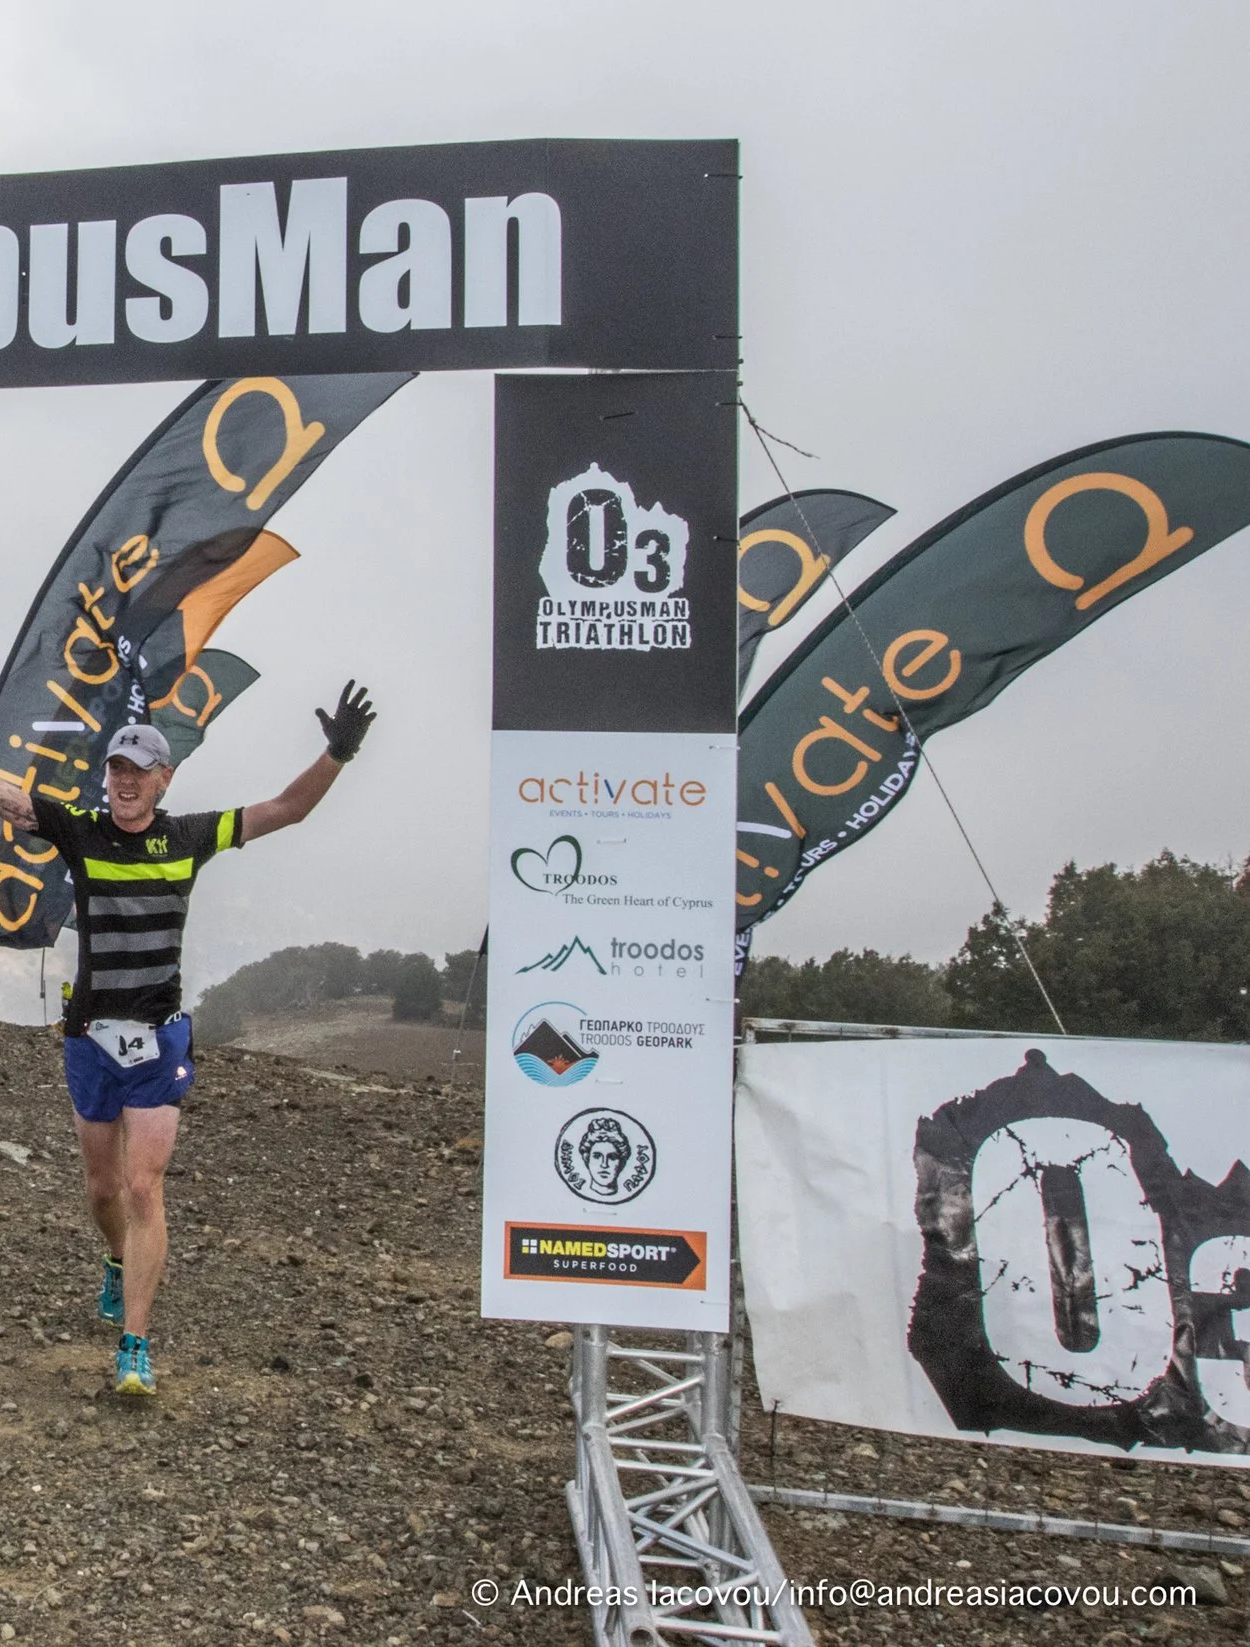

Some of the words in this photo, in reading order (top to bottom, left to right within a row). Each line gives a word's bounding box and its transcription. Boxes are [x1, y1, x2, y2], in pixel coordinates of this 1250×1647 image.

[542, 600, 687, 619] OLYMPUSMAN
[539, 621, 688, 646] TRIATHLON
[518, 771, 707, 806] activate
[550, 809, 582, 818] EVENTS
[591, 810, 619, 819] TOURS
[627, 811, 671, 820] HOLIDAYS
[543, 873, 618, 886] TROODOS
[562, 894, 583, 905] The
[586, 894, 620, 906] Green
[624, 895, 655, 907] Heart
[657, 896, 671, 908] of
[672, 896, 713, 911] Cyprus
[610, 937, 705, 962] troodos
[611, 962, 704, 978] hotel
[580, 1033, 632, 1046] TROODOS
[637, 1035, 693, 1049] GEOPARK
[553, 1259, 638, 1273] SUPERFOOD
